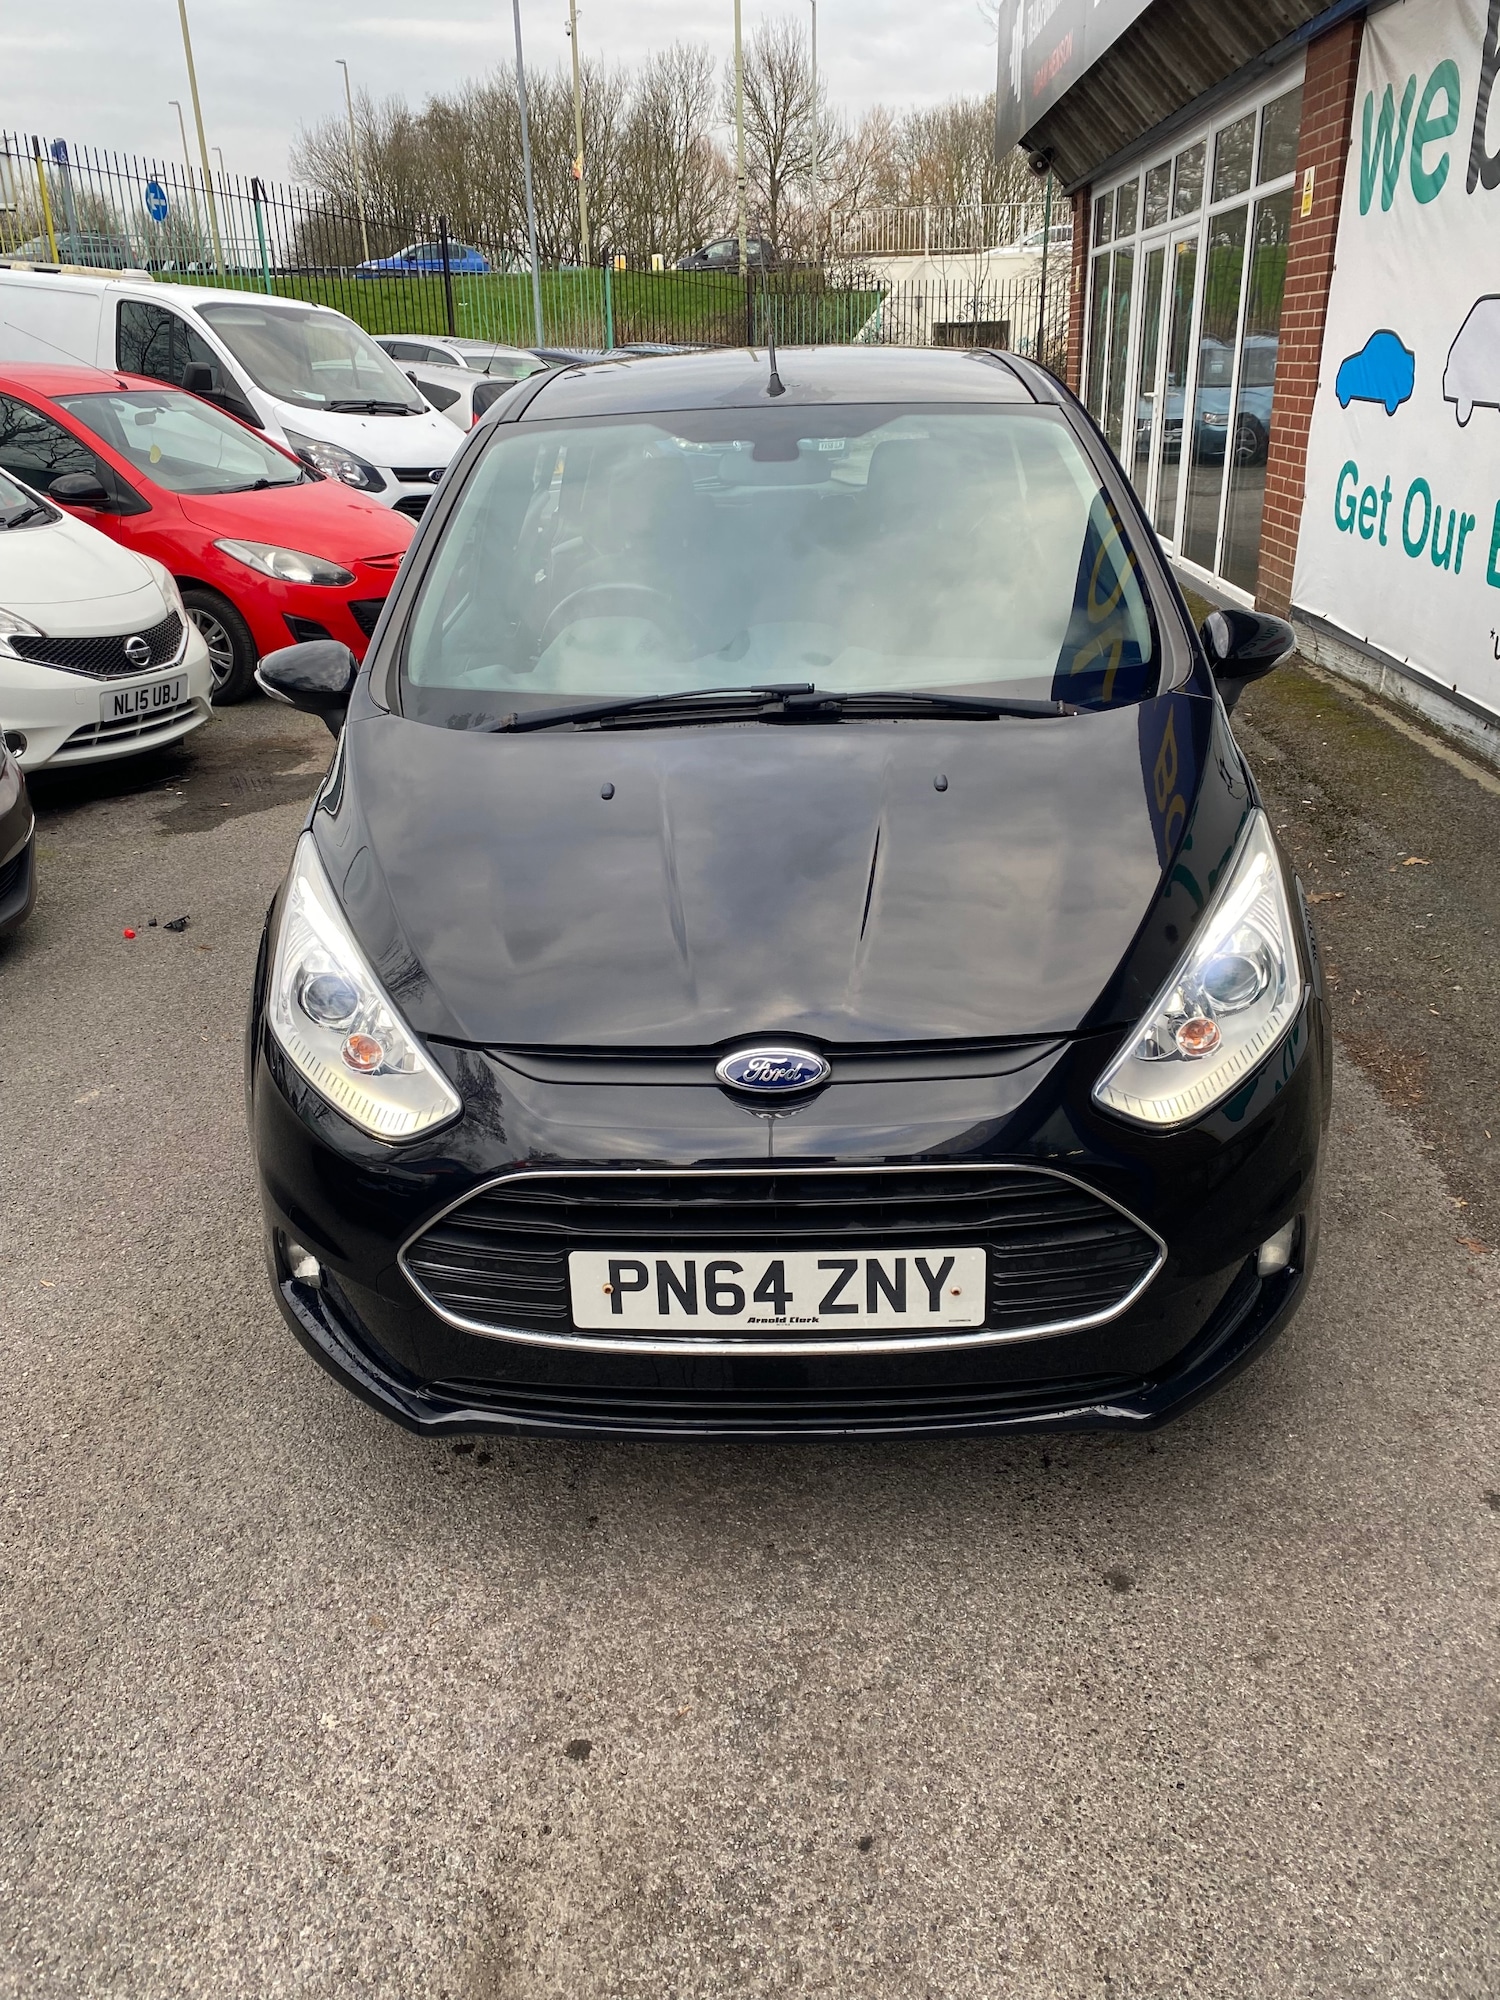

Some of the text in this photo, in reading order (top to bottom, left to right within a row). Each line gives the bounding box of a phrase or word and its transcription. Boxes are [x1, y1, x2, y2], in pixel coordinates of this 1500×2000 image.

[1335, 460, 1392, 546] Get
[1402, 477, 1476, 575] Our
[114, 681, 179, 715] NL15 UBJ
[743, 1058, 803, 1082] Ford
[608, 1256, 956, 1315] PN64 ZNY
[747, 1316, 820, 1324] Arnold Clark
